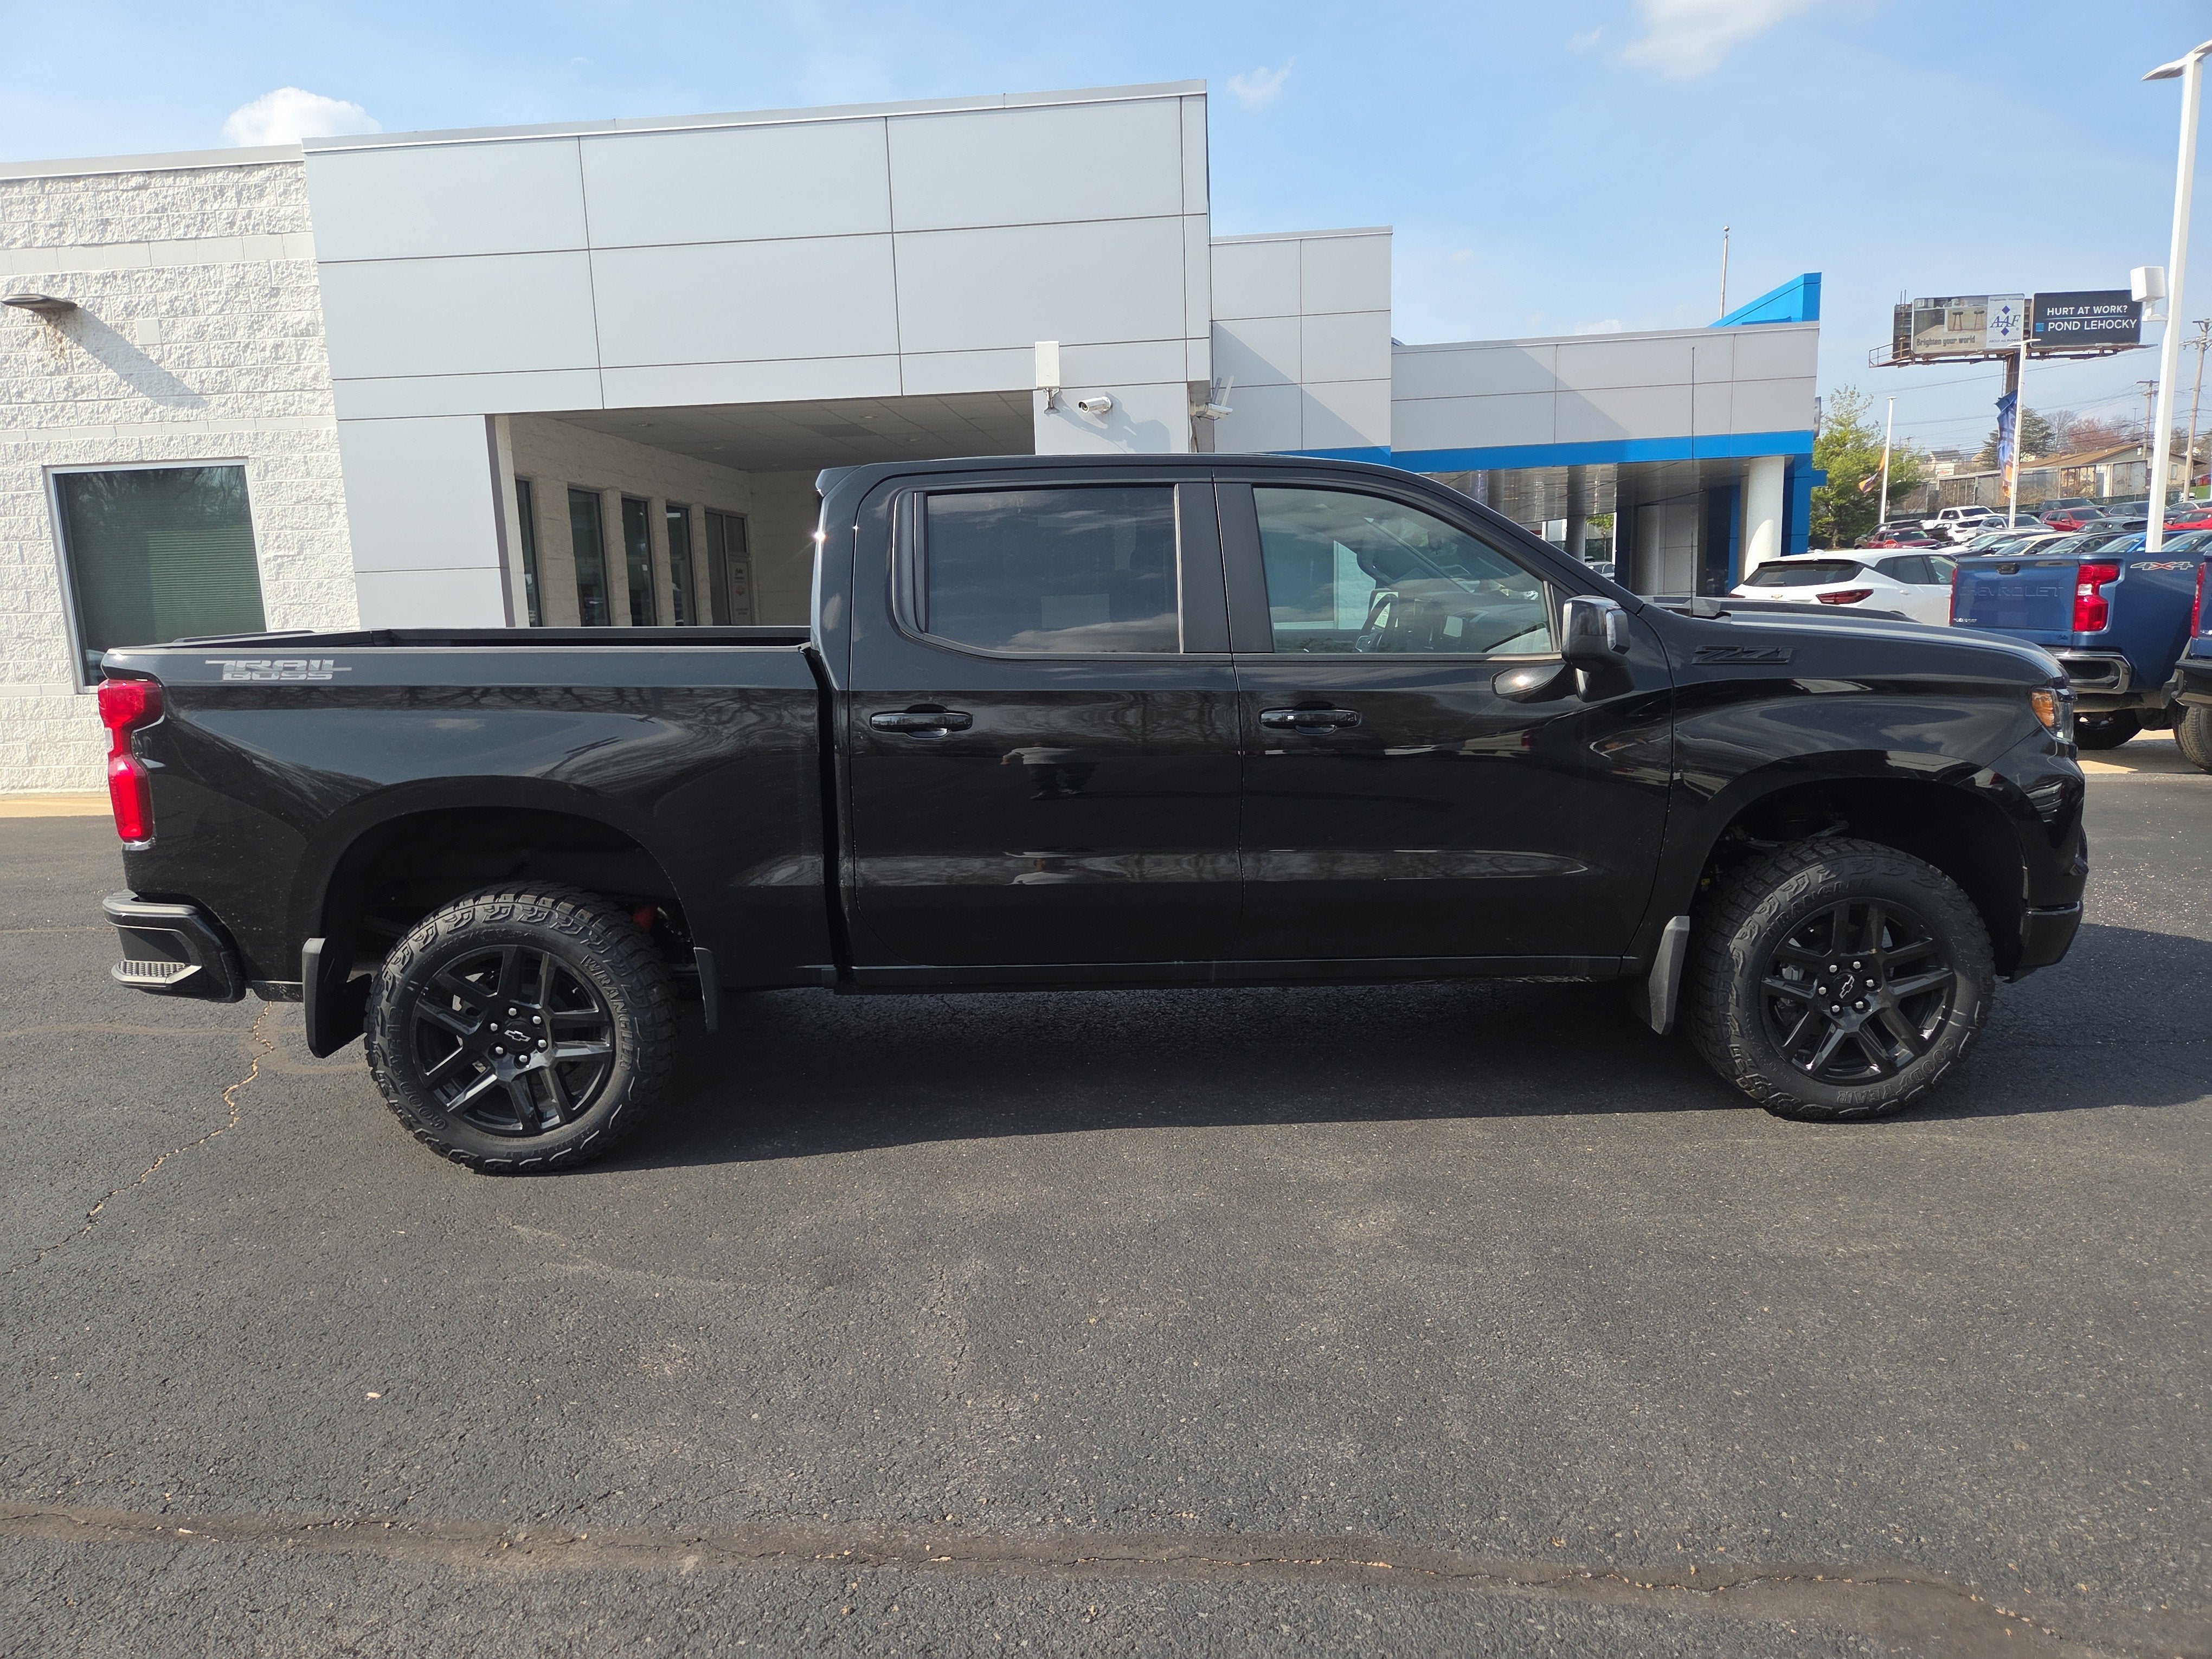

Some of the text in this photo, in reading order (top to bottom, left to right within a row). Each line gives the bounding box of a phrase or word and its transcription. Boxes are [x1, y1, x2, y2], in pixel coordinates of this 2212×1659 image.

[2047, 305, 2128, 316] HURT AT WORK?
[1990, 314, 2021, 328] AAF
[2048, 319, 2137, 332] POND LEHOCKY
[1917, 335, 1976, 348] Brighten your world
[1690, 644, 1796, 665] Z71
[580, 954, 633, 1071] WRANGLER
[1836, 1037, 1956, 1104] GOODYEAR
